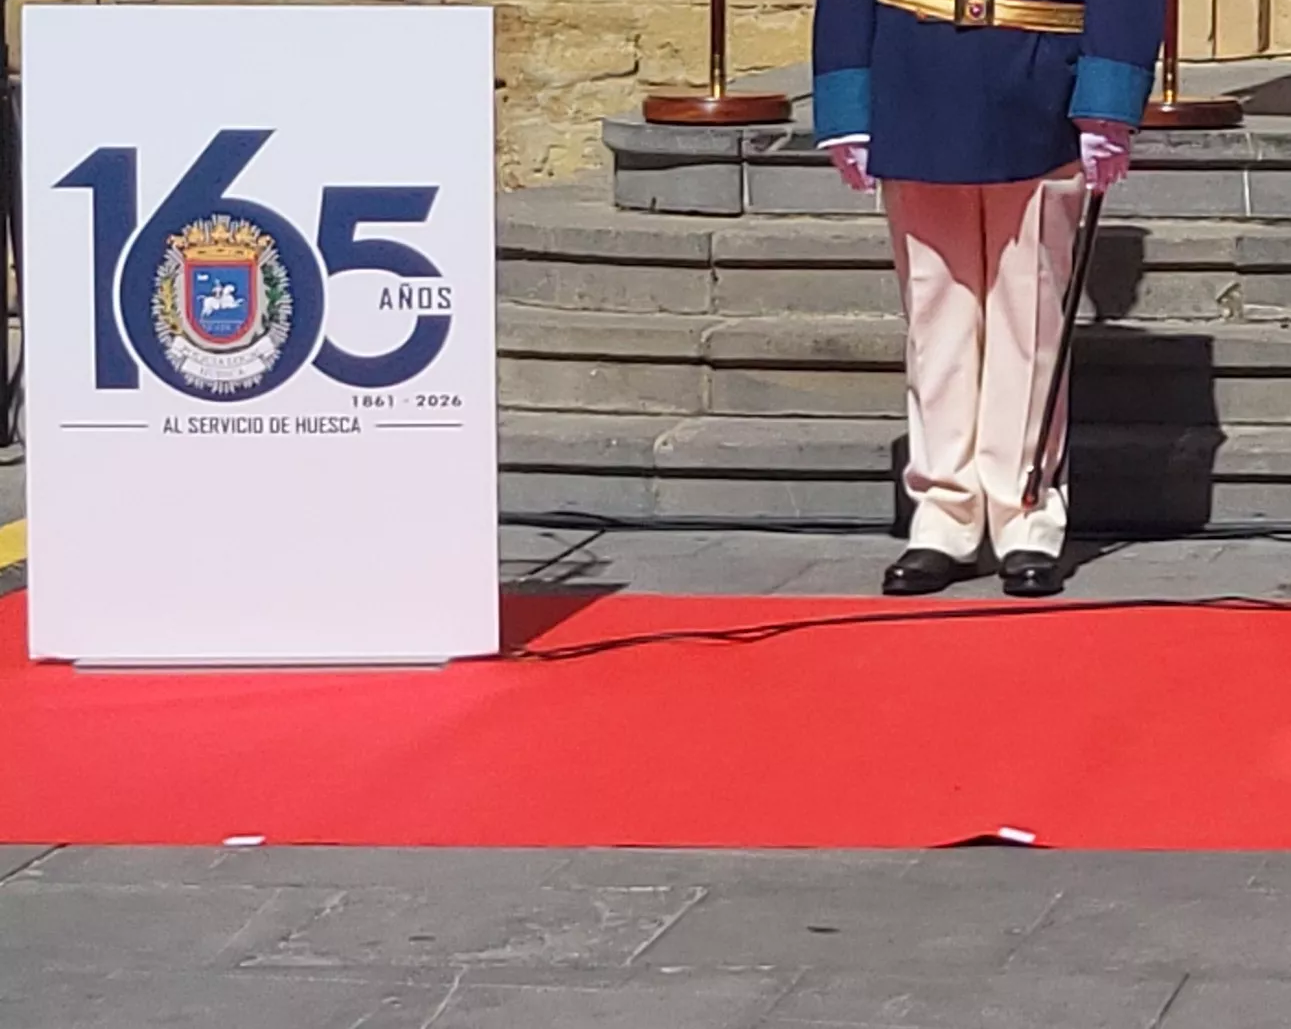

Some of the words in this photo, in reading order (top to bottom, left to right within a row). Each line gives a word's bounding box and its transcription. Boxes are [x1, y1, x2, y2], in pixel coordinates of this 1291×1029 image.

[50, 128, 454, 403] 165
[378, 282, 453, 311] AÑOS
[351, 394, 394, 409] 1861
[415, 394, 463, 408] 2026
[163, 417, 183, 435] AL
[187, 417, 264, 434] SERVICIO
[269, 417, 290, 434] DE
[295, 416, 361, 434] HUESCA
